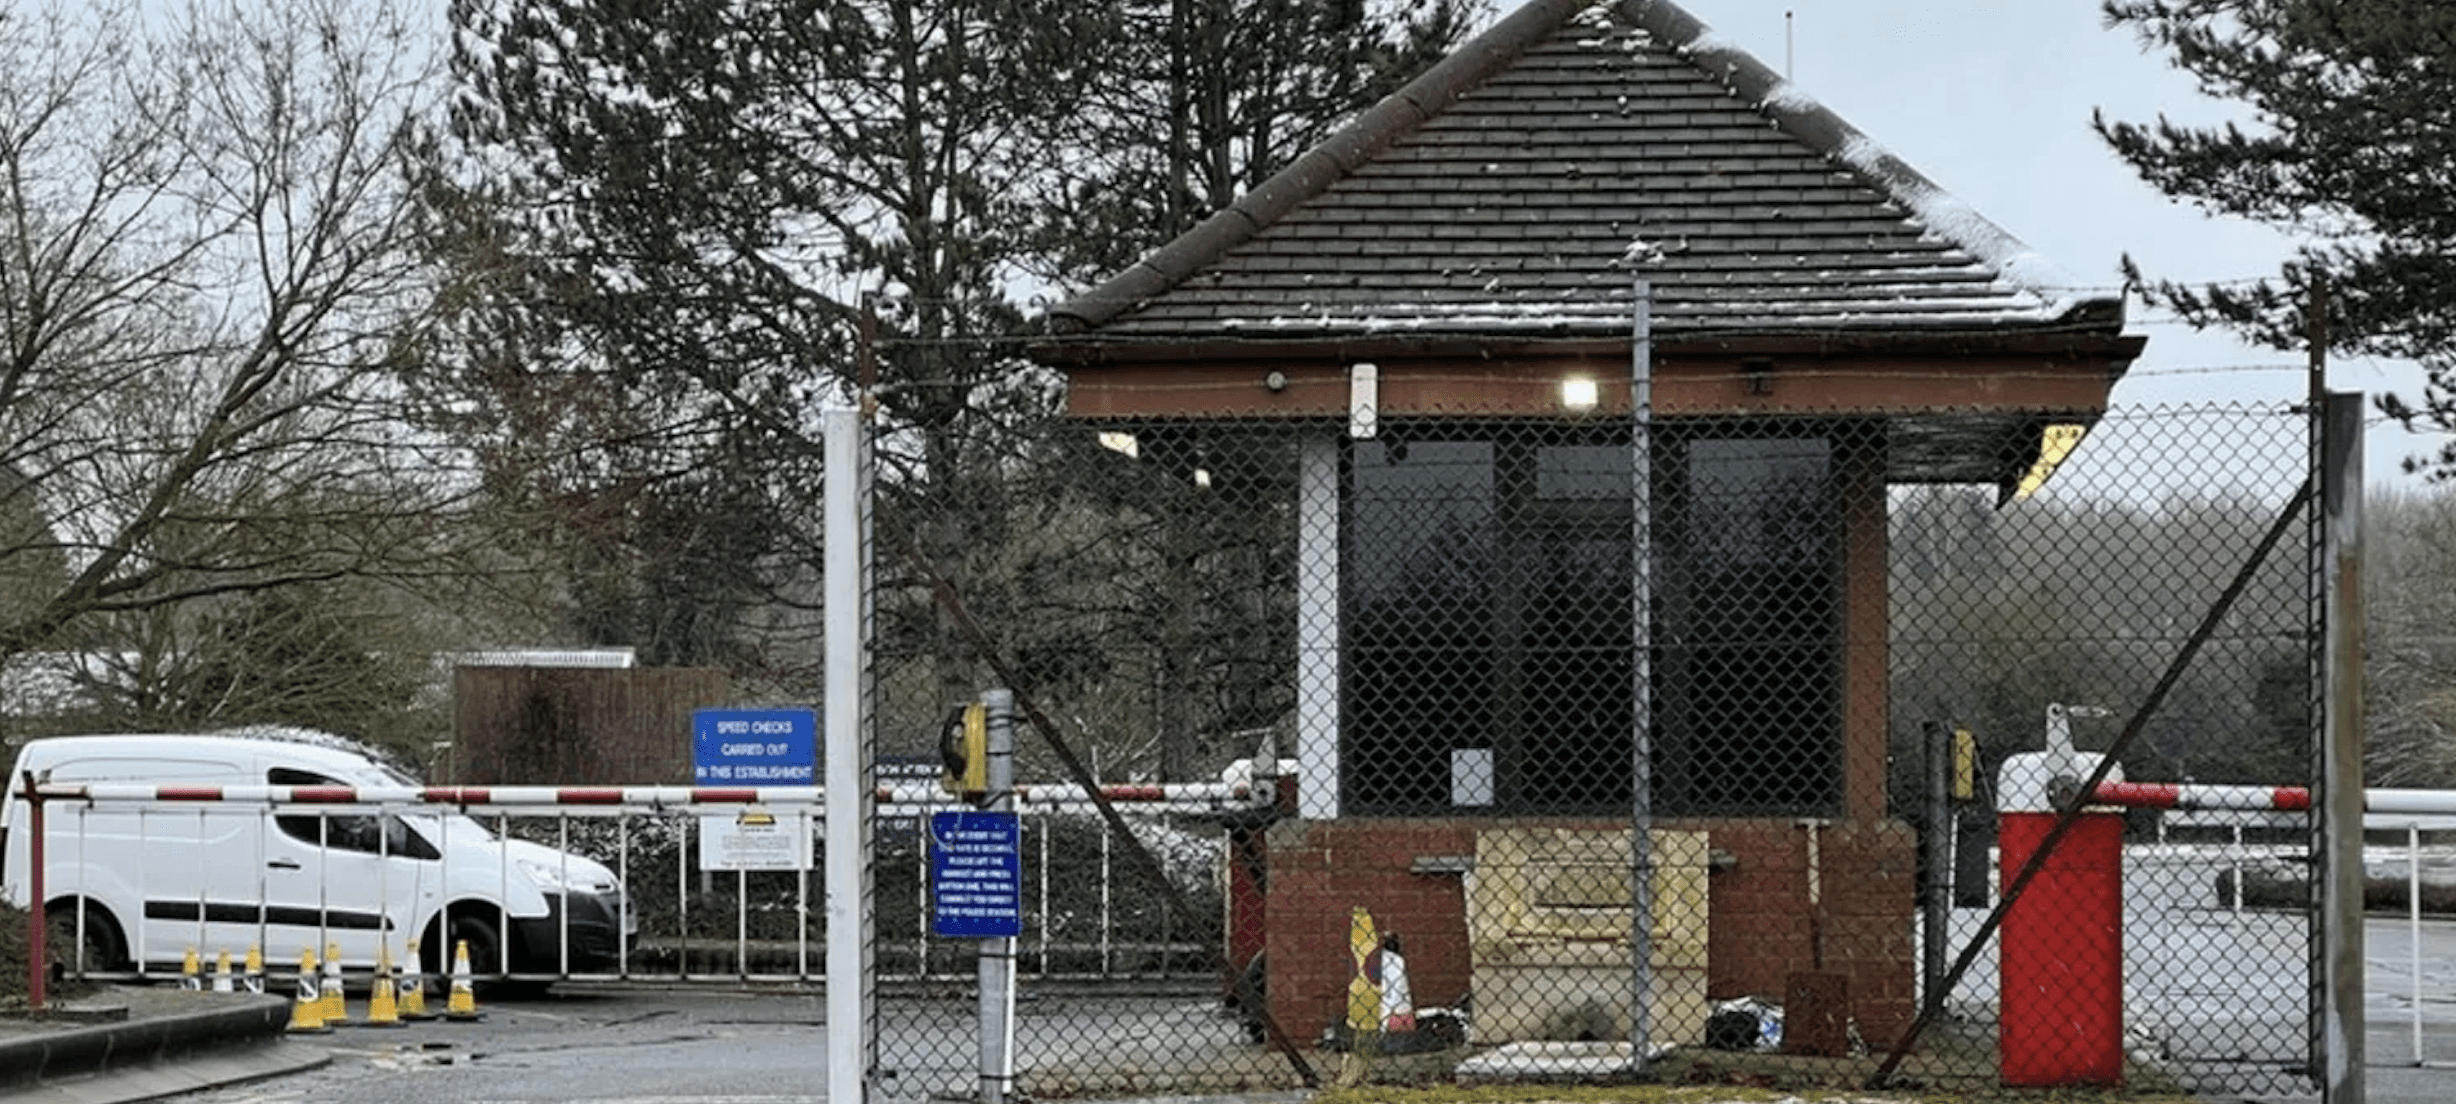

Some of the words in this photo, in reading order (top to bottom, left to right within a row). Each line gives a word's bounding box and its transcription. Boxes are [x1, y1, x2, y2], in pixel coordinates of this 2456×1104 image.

[717, 721, 750, 734] SPEED
[751, 721, 793, 734] CHECKS
[720, 743, 765, 756] CARRIED
[766, 743, 789, 756] OUT
[696, 765, 708, 778] IN
[709, 765, 732, 778] THIS
[734, 765, 812, 779] ESTABLISHMENT
